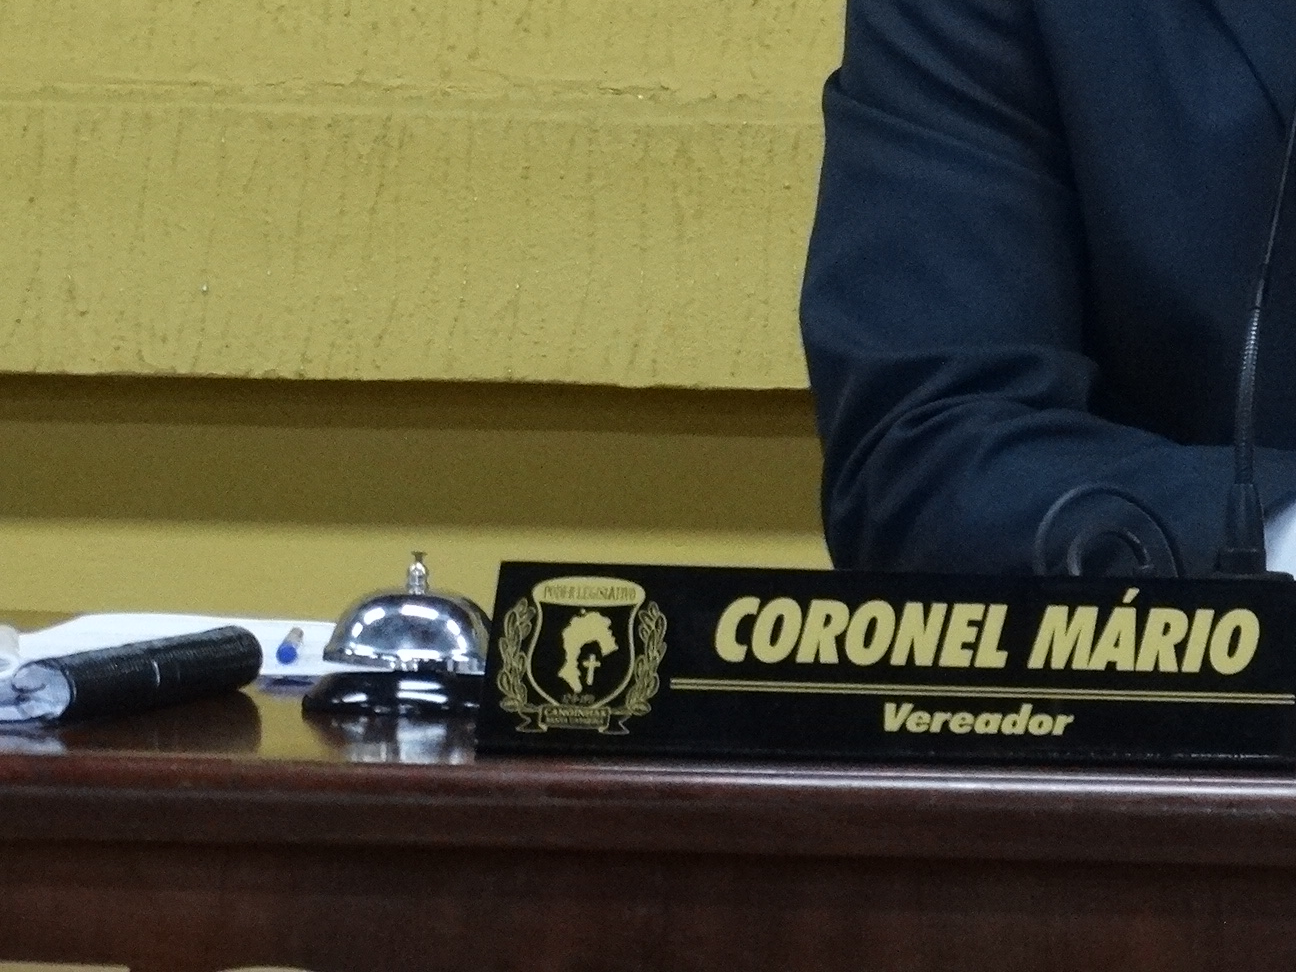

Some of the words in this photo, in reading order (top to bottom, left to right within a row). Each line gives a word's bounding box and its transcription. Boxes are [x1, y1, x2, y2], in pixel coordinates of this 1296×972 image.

[714, 596, 1009, 668] CORONEL
[1027, 587, 1260, 675] MÁRIO
[884, 702, 1075, 736] Vereador
